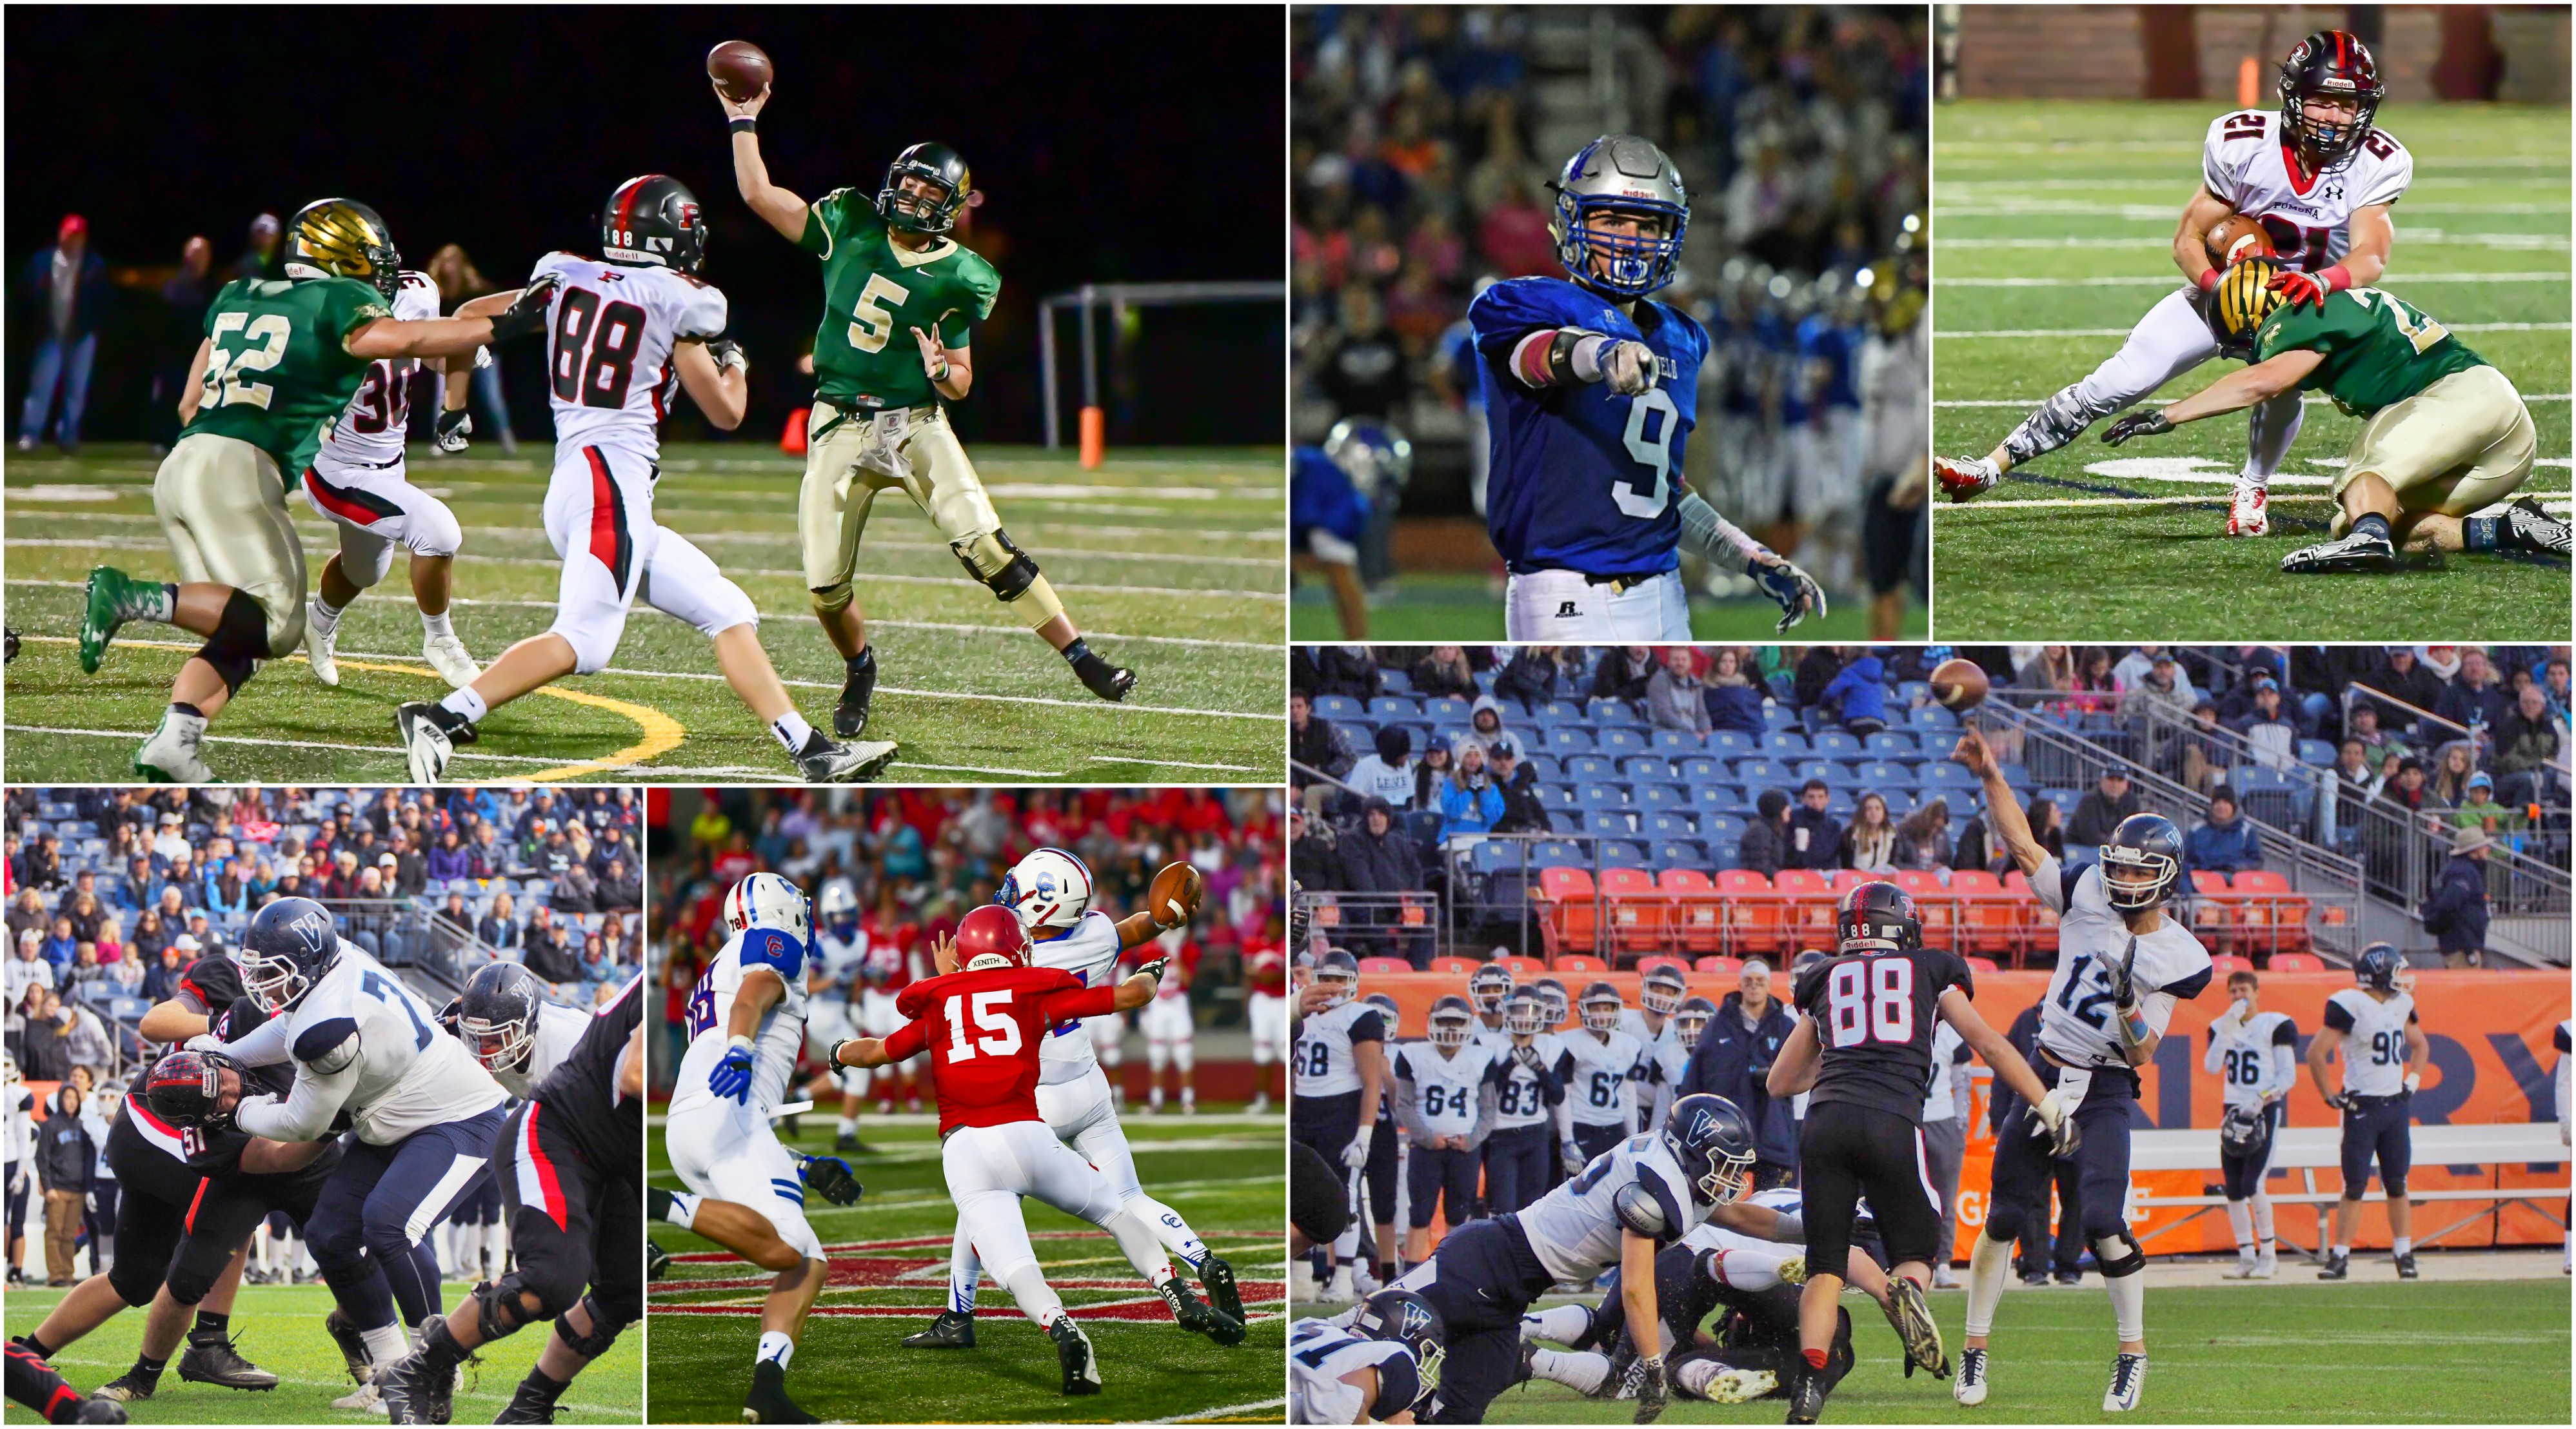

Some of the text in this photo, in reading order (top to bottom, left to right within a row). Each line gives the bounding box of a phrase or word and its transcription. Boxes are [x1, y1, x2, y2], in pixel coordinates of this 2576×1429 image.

[2327, 79, 2352, 88] Riddell
[2224, 113, 2266, 143] 21
[2274, 201, 2319, 220] POMONA
[612, 229, 632, 247] 88
[847, 272, 909, 354] 5
[198, 312, 292, 411] 52
[552, 286, 647, 410] 88
[1611, 387, 1679, 518] 9
[290, 911, 322, 952] V
[729, 917, 742, 932] 78
[1850, 923, 1870, 938] 88
[973, 957, 1000, 968] XENITH
[1845, 940, 1876, 949] Riddell
[1828, 957, 1914, 1049] 88
[2056, 953, 2116, 1032] 12
[944, 989, 1023, 1065] 15
[1296, 1040, 1329, 1077] 58
[2372, 1030, 2403, 1066] 90
[1425, 1085, 1468, 1118] 64
[1499, 1080, 1540, 1116] 83
[1590, 1071, 1624, 1109] 67
[1686, 1109, 1724, 1147] V
[1400, 1301, 1432, 1341] V
